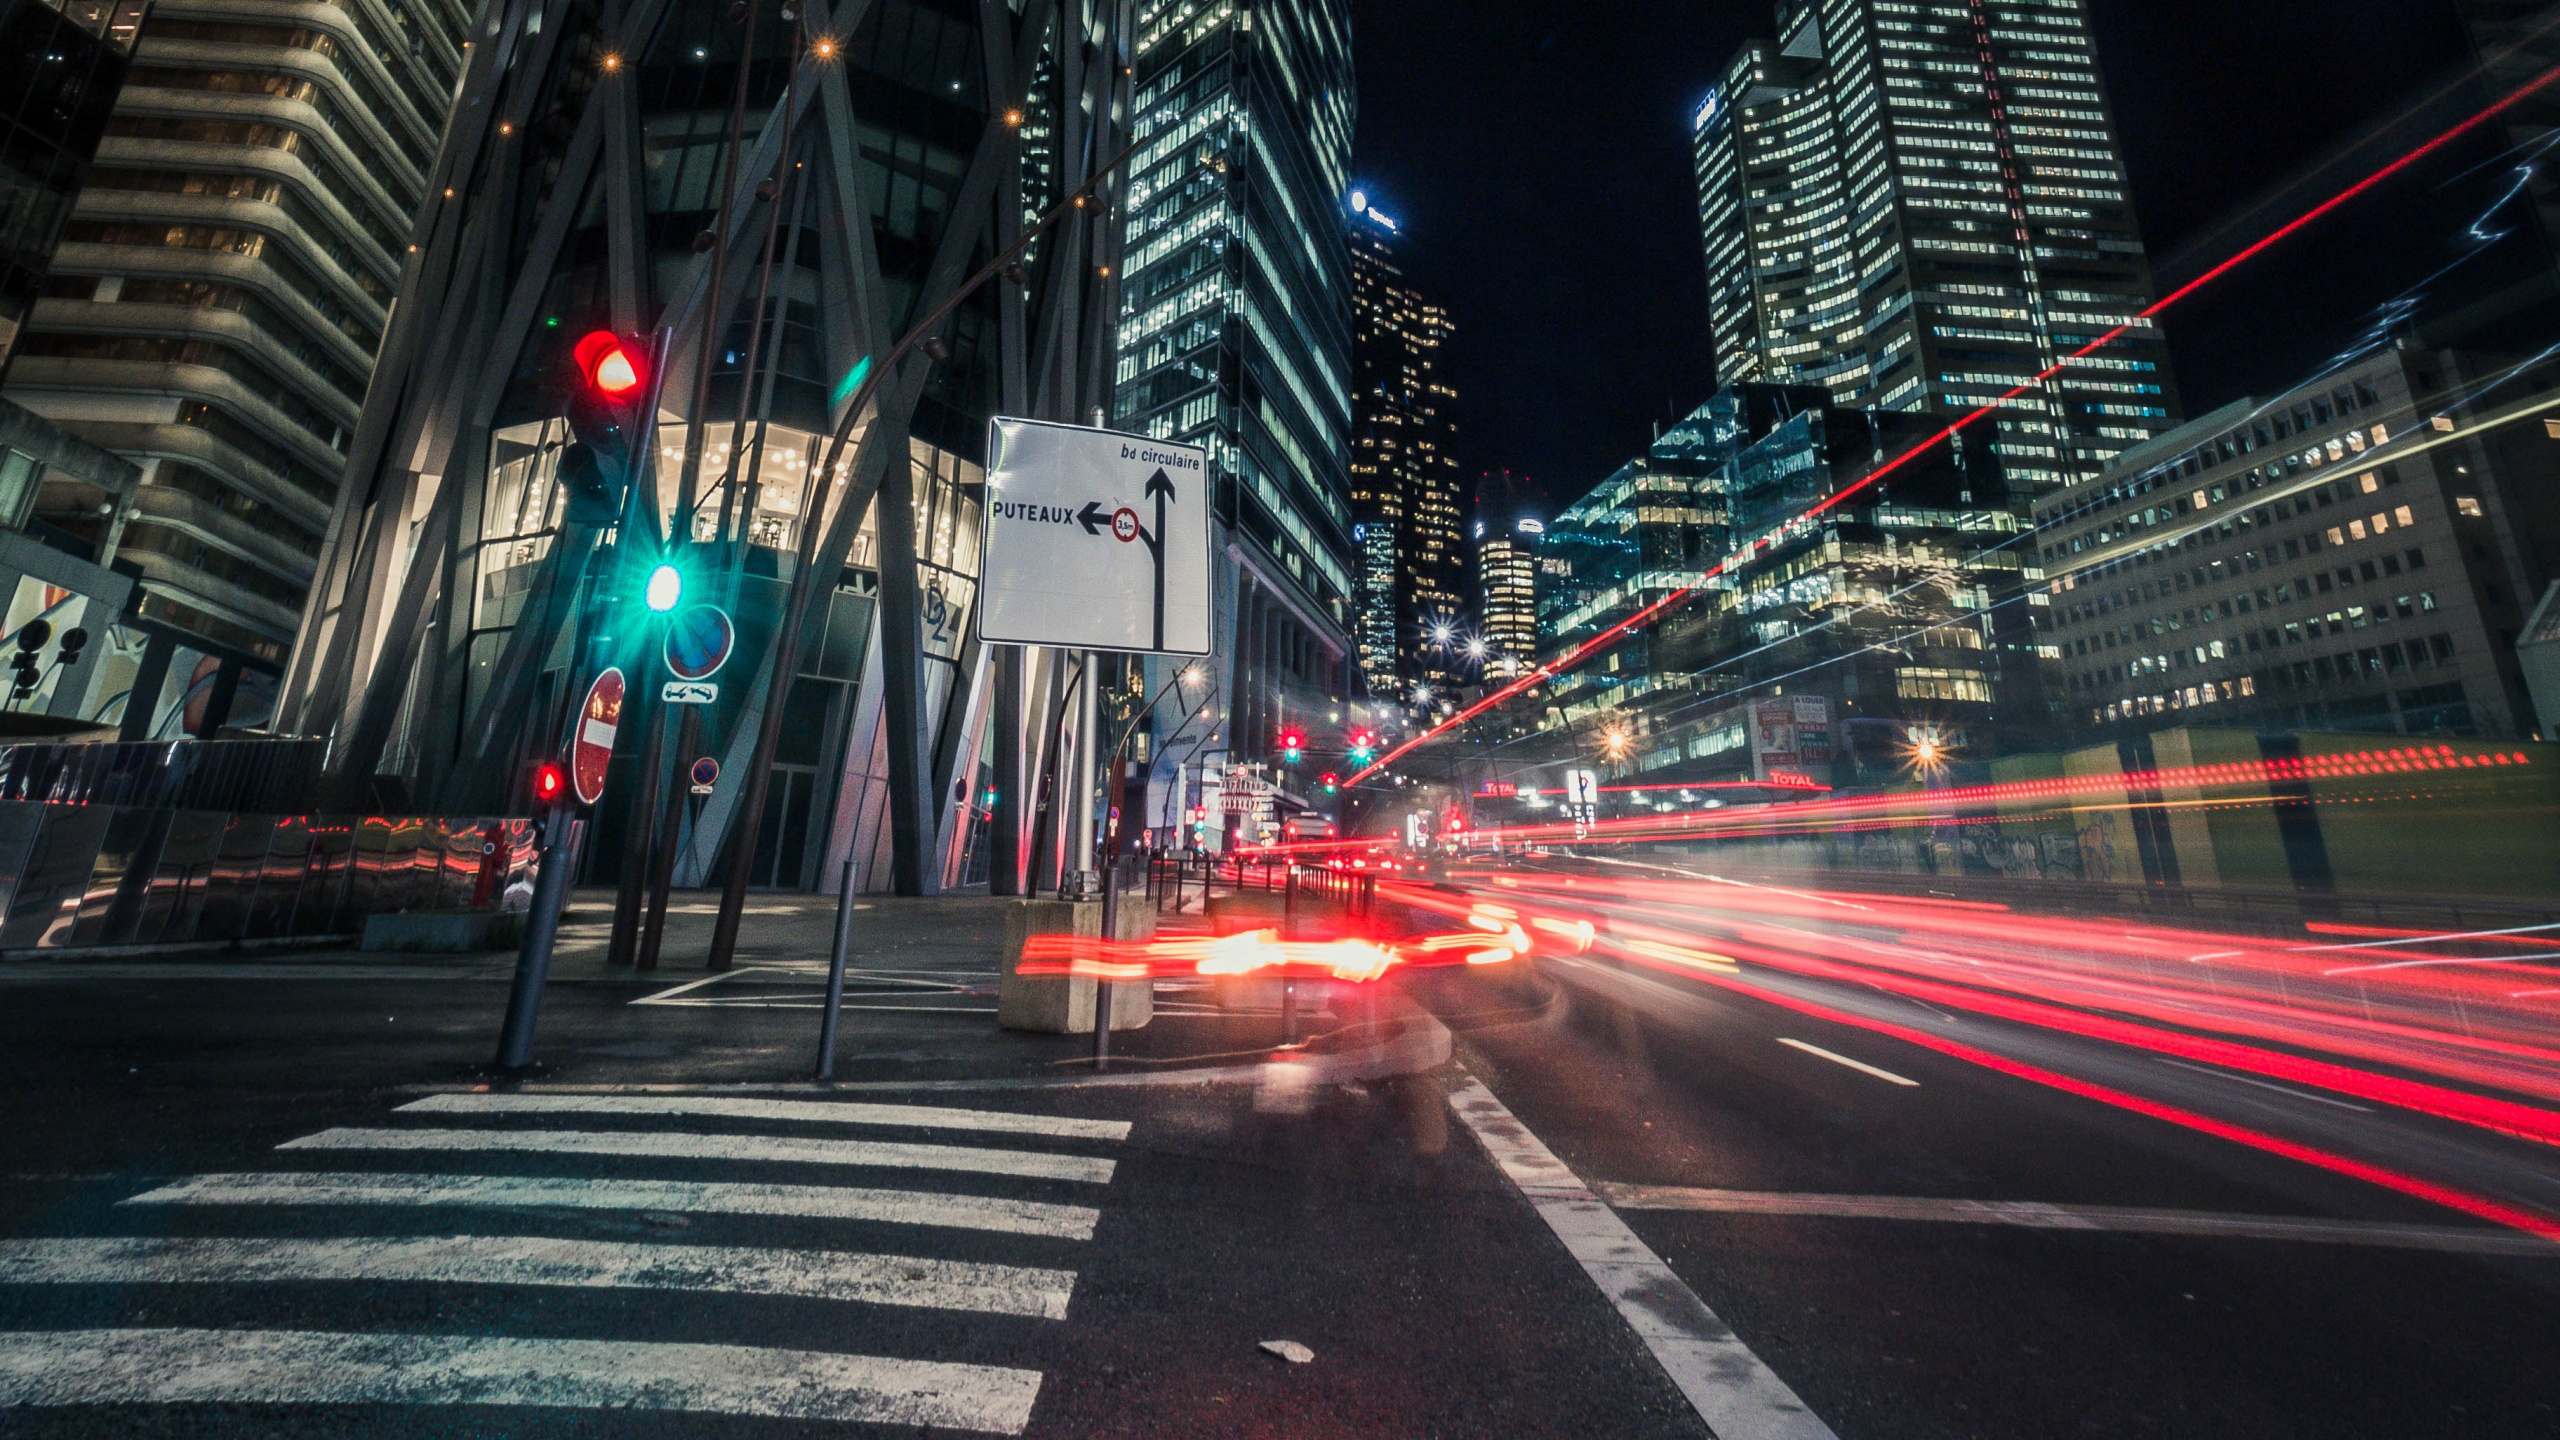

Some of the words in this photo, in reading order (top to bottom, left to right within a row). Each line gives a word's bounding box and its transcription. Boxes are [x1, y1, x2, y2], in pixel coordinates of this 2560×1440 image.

[1121, 443, 1137, 460] bd
[1141, 448, 1200, 471] circulaire
[993, 501, 1074, 525] PUTEAUX
[1117, 519, 1134, 531] 3,5m
[1769, 770, 1816, 786] TOTAL
